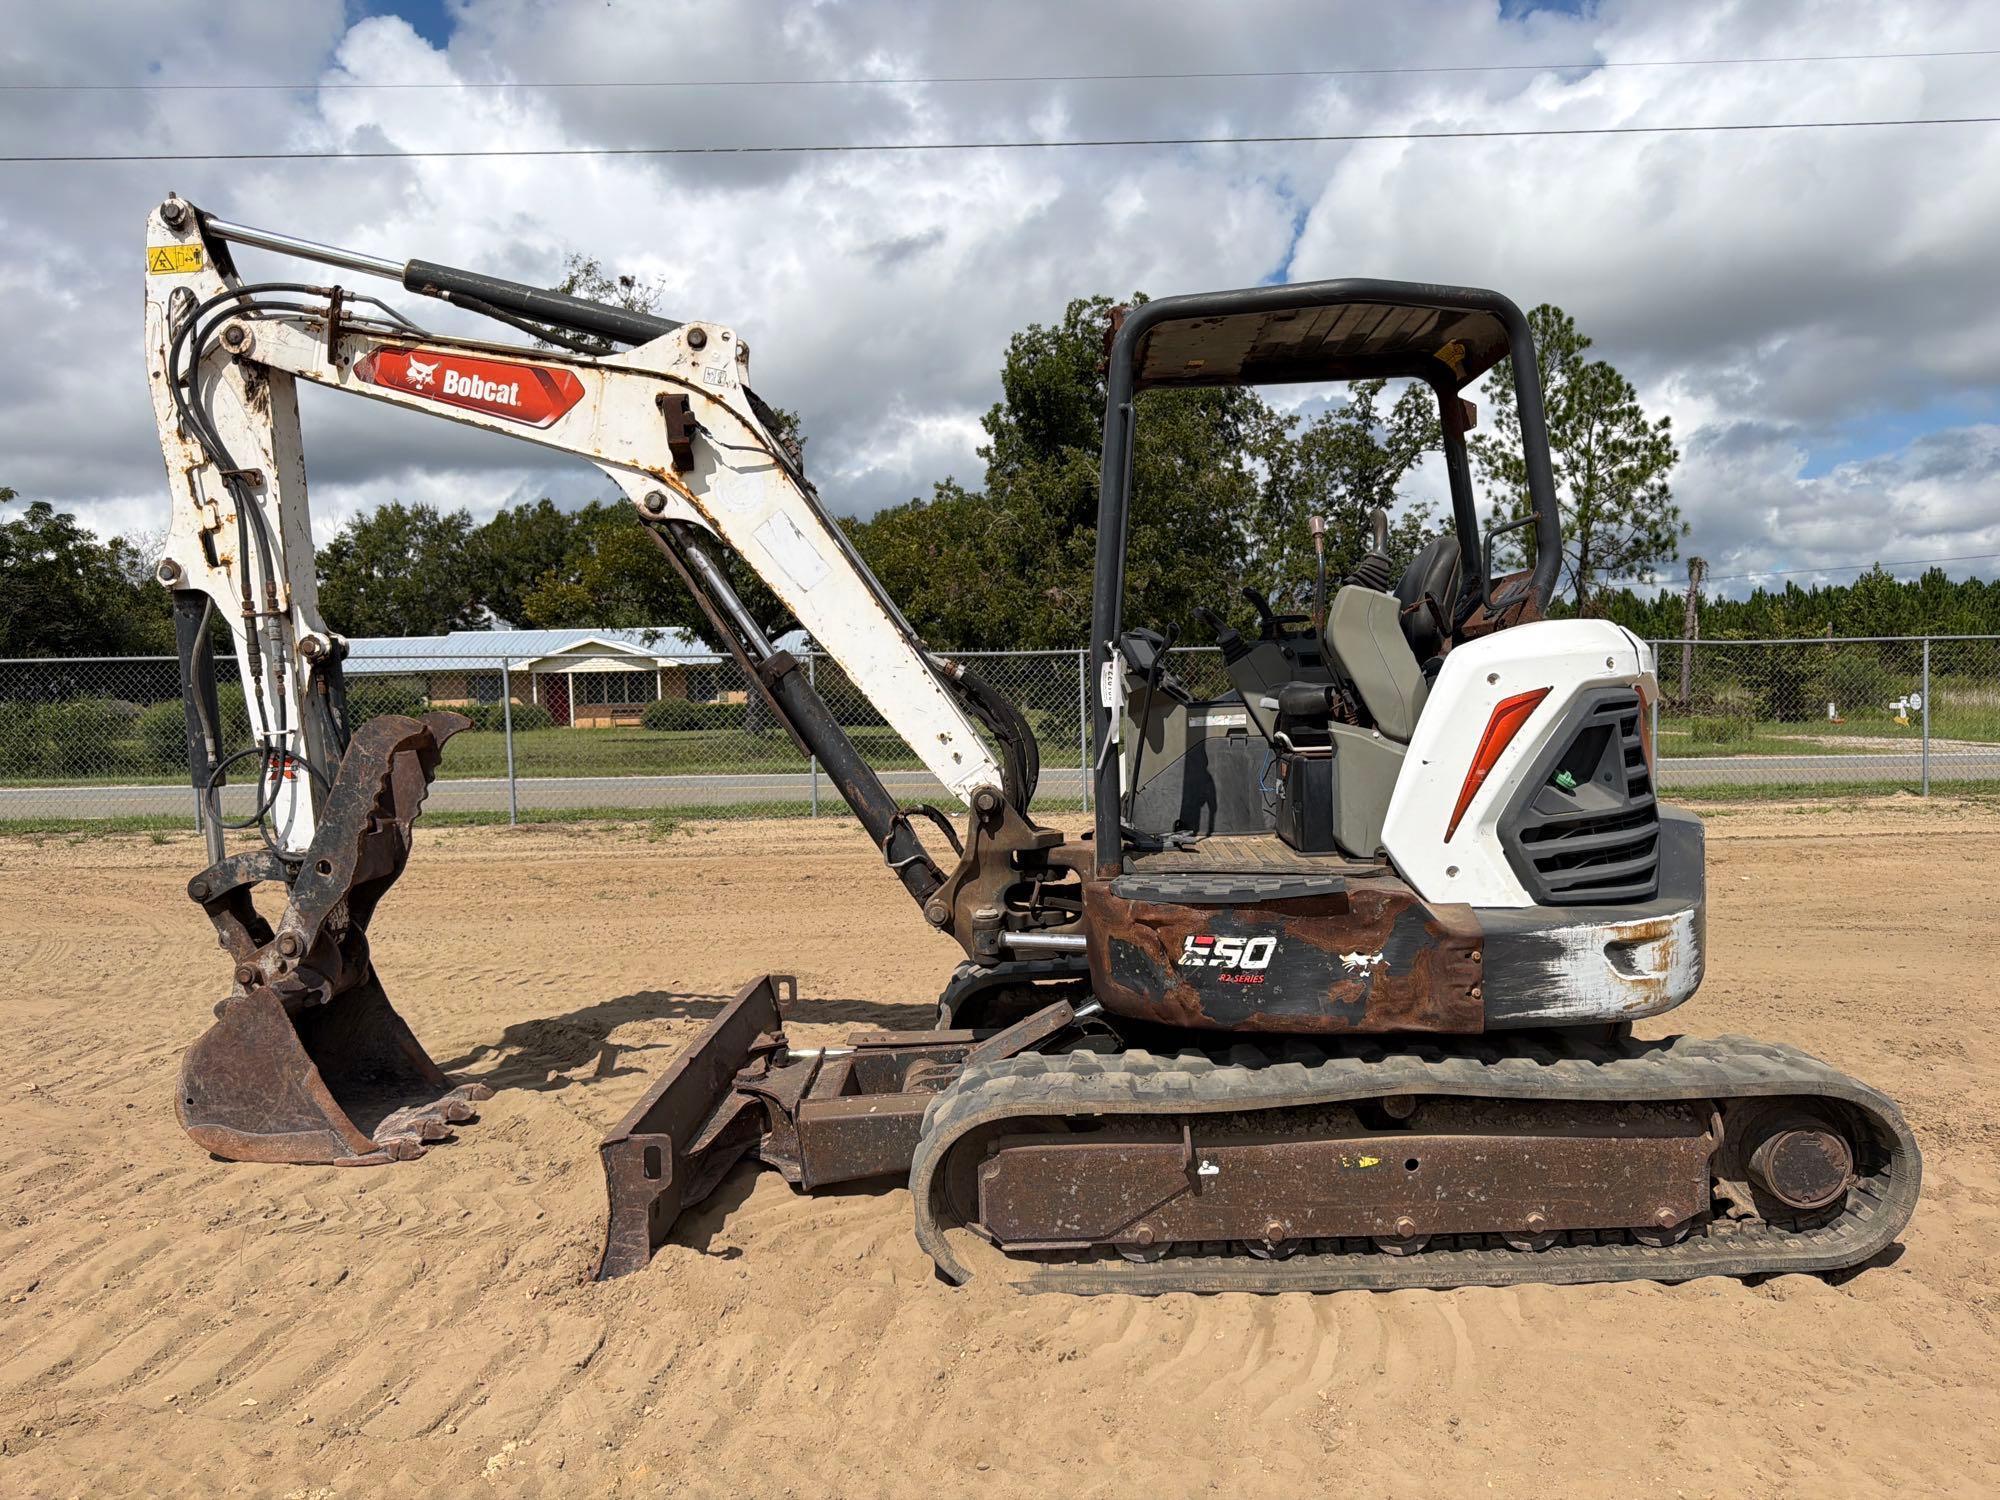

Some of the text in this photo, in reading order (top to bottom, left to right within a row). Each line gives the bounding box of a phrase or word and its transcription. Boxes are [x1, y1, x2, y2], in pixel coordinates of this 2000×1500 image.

[443, 369, 520, 406] Bobcat
[1178, 935, 1277, 968] E50
[1234, 974, 1265, 983] SERIES
